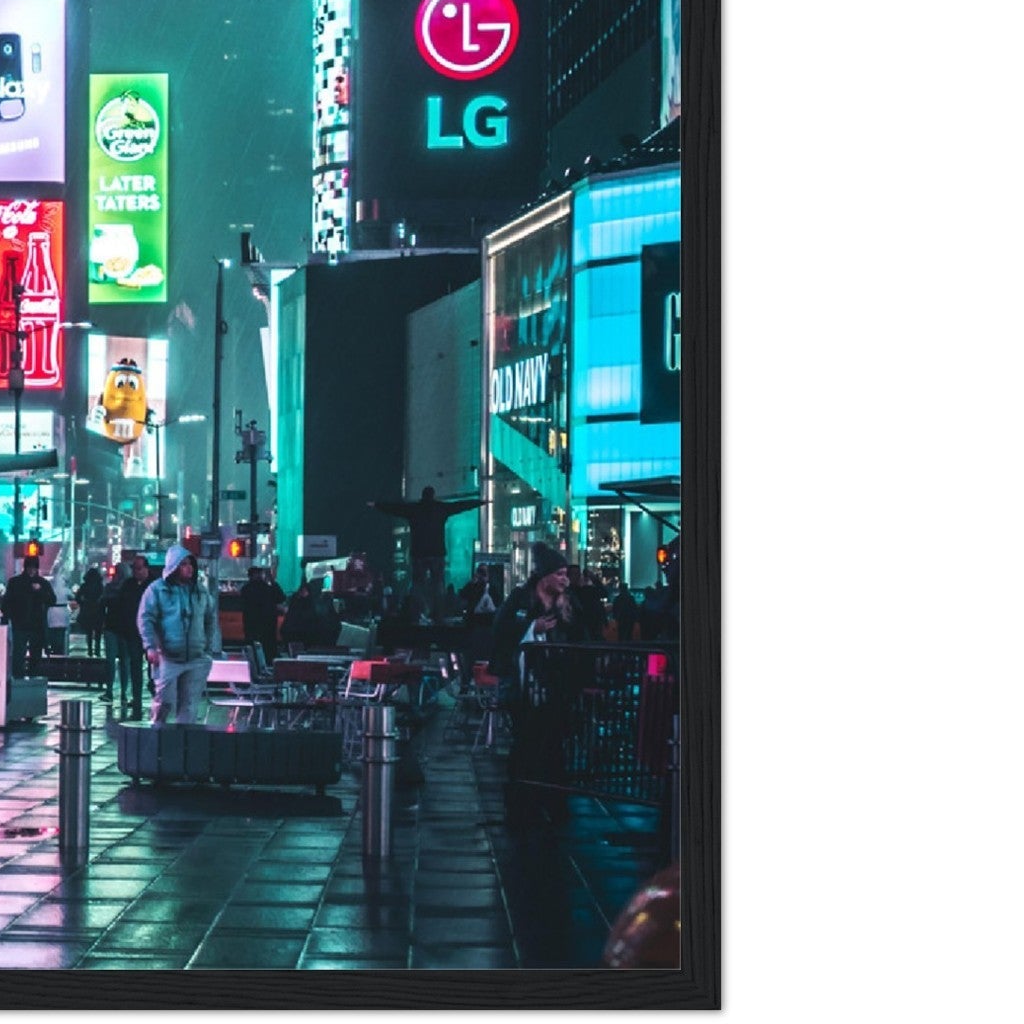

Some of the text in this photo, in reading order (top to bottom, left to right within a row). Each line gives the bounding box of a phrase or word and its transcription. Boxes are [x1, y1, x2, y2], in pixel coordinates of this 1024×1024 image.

[426, 94, 509, 149] LG
[103, 126, 157, 141] Green
[98, 175, 157, 192] LATER
[94, 194, 161, 212] TATERS
[492, 352, 549, 414] OLD NAVY
